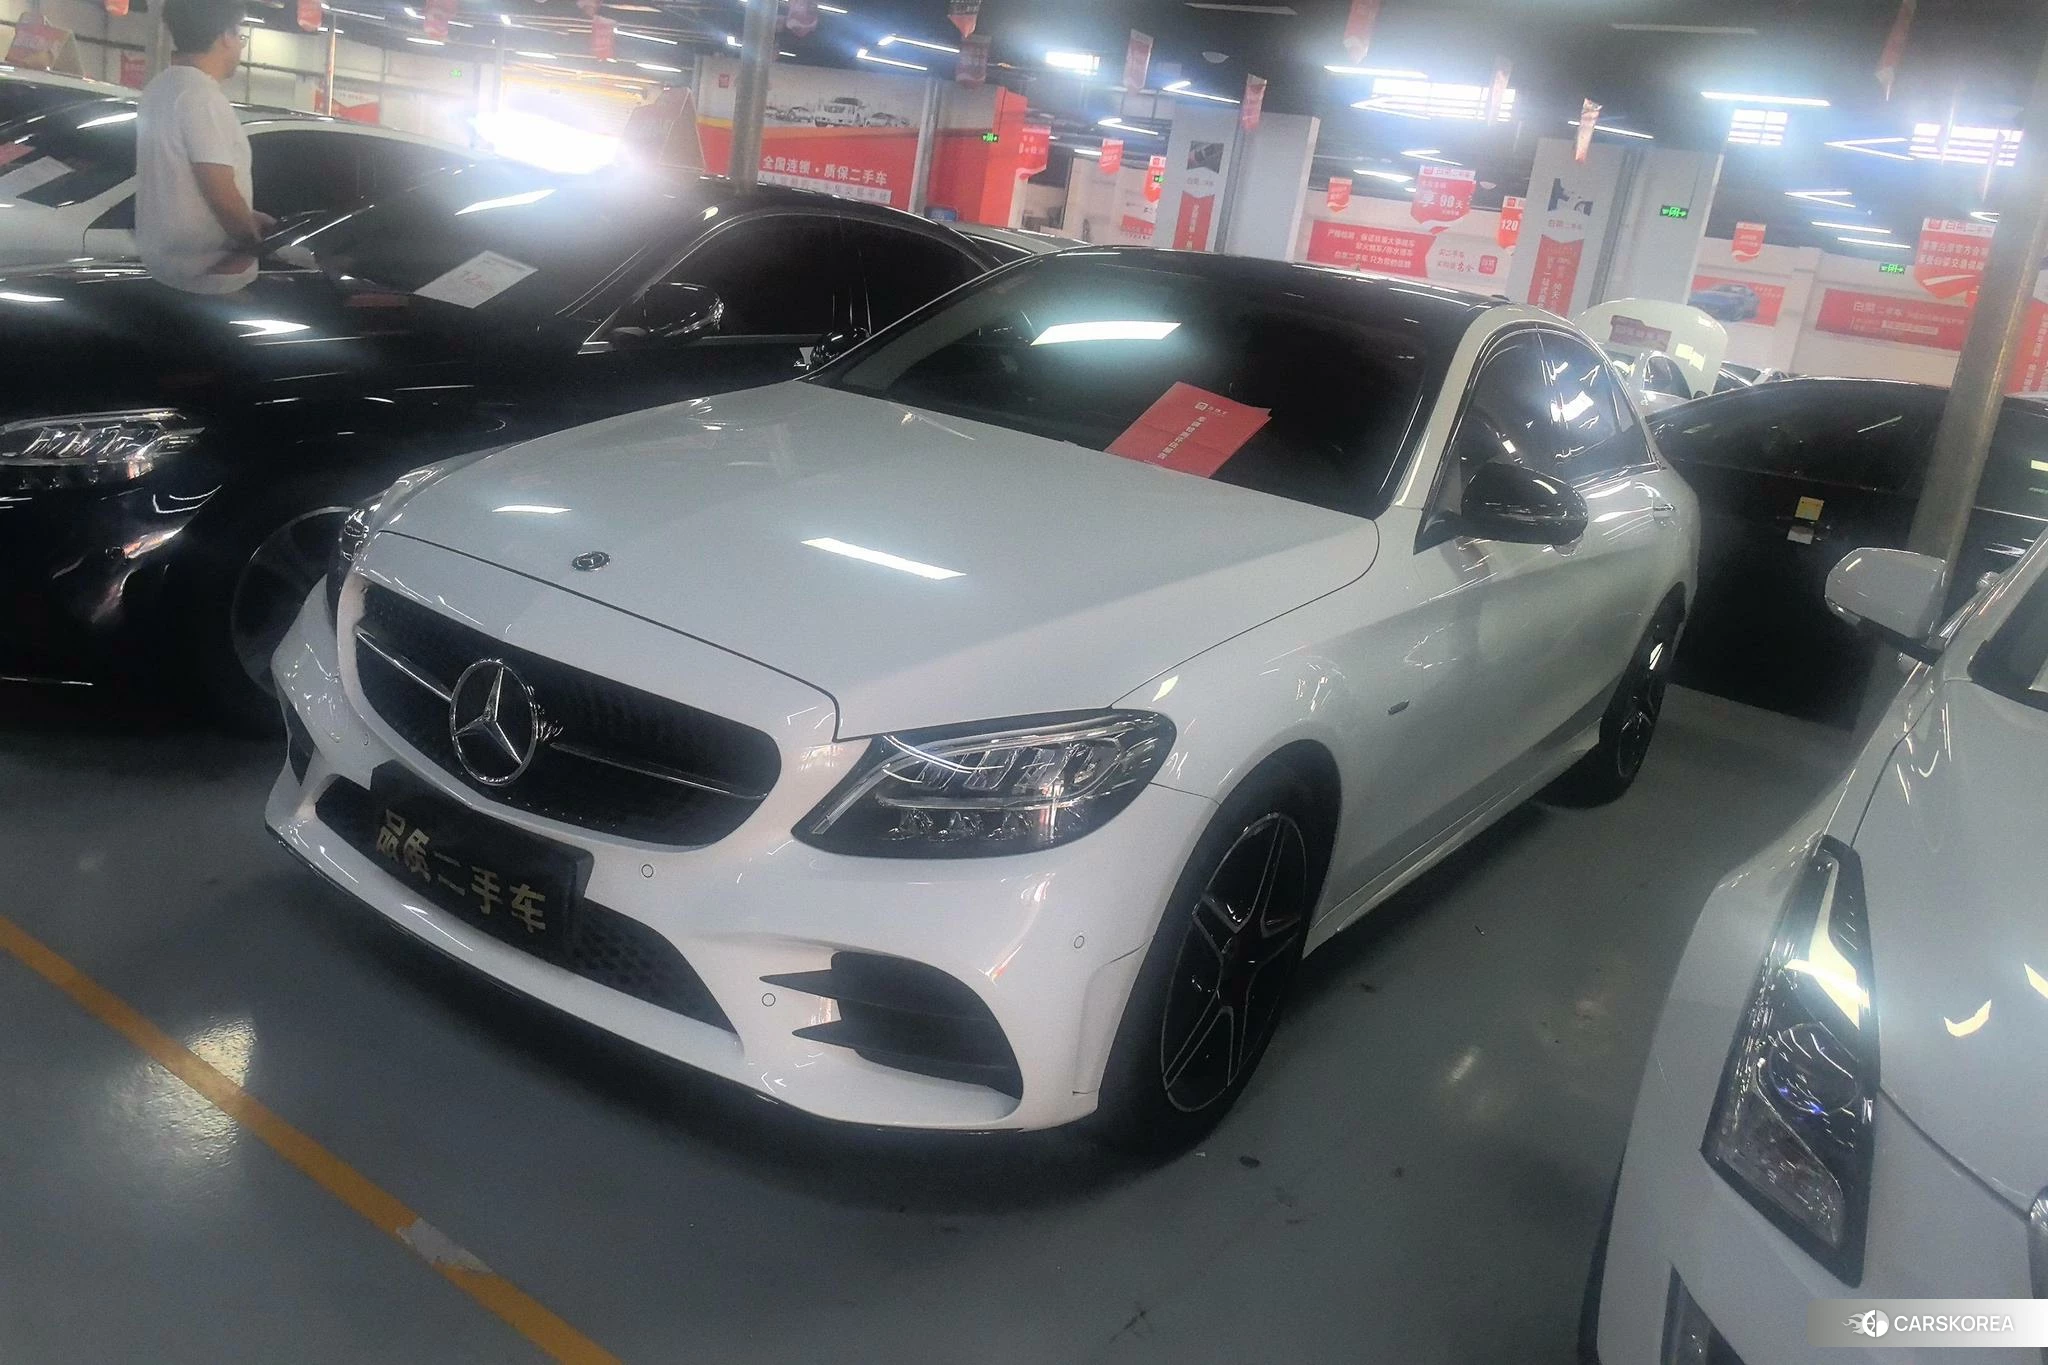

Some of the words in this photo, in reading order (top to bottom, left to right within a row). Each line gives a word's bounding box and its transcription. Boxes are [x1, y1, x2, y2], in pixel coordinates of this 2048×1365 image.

[375, 808, 546, 934] 品质二手车
